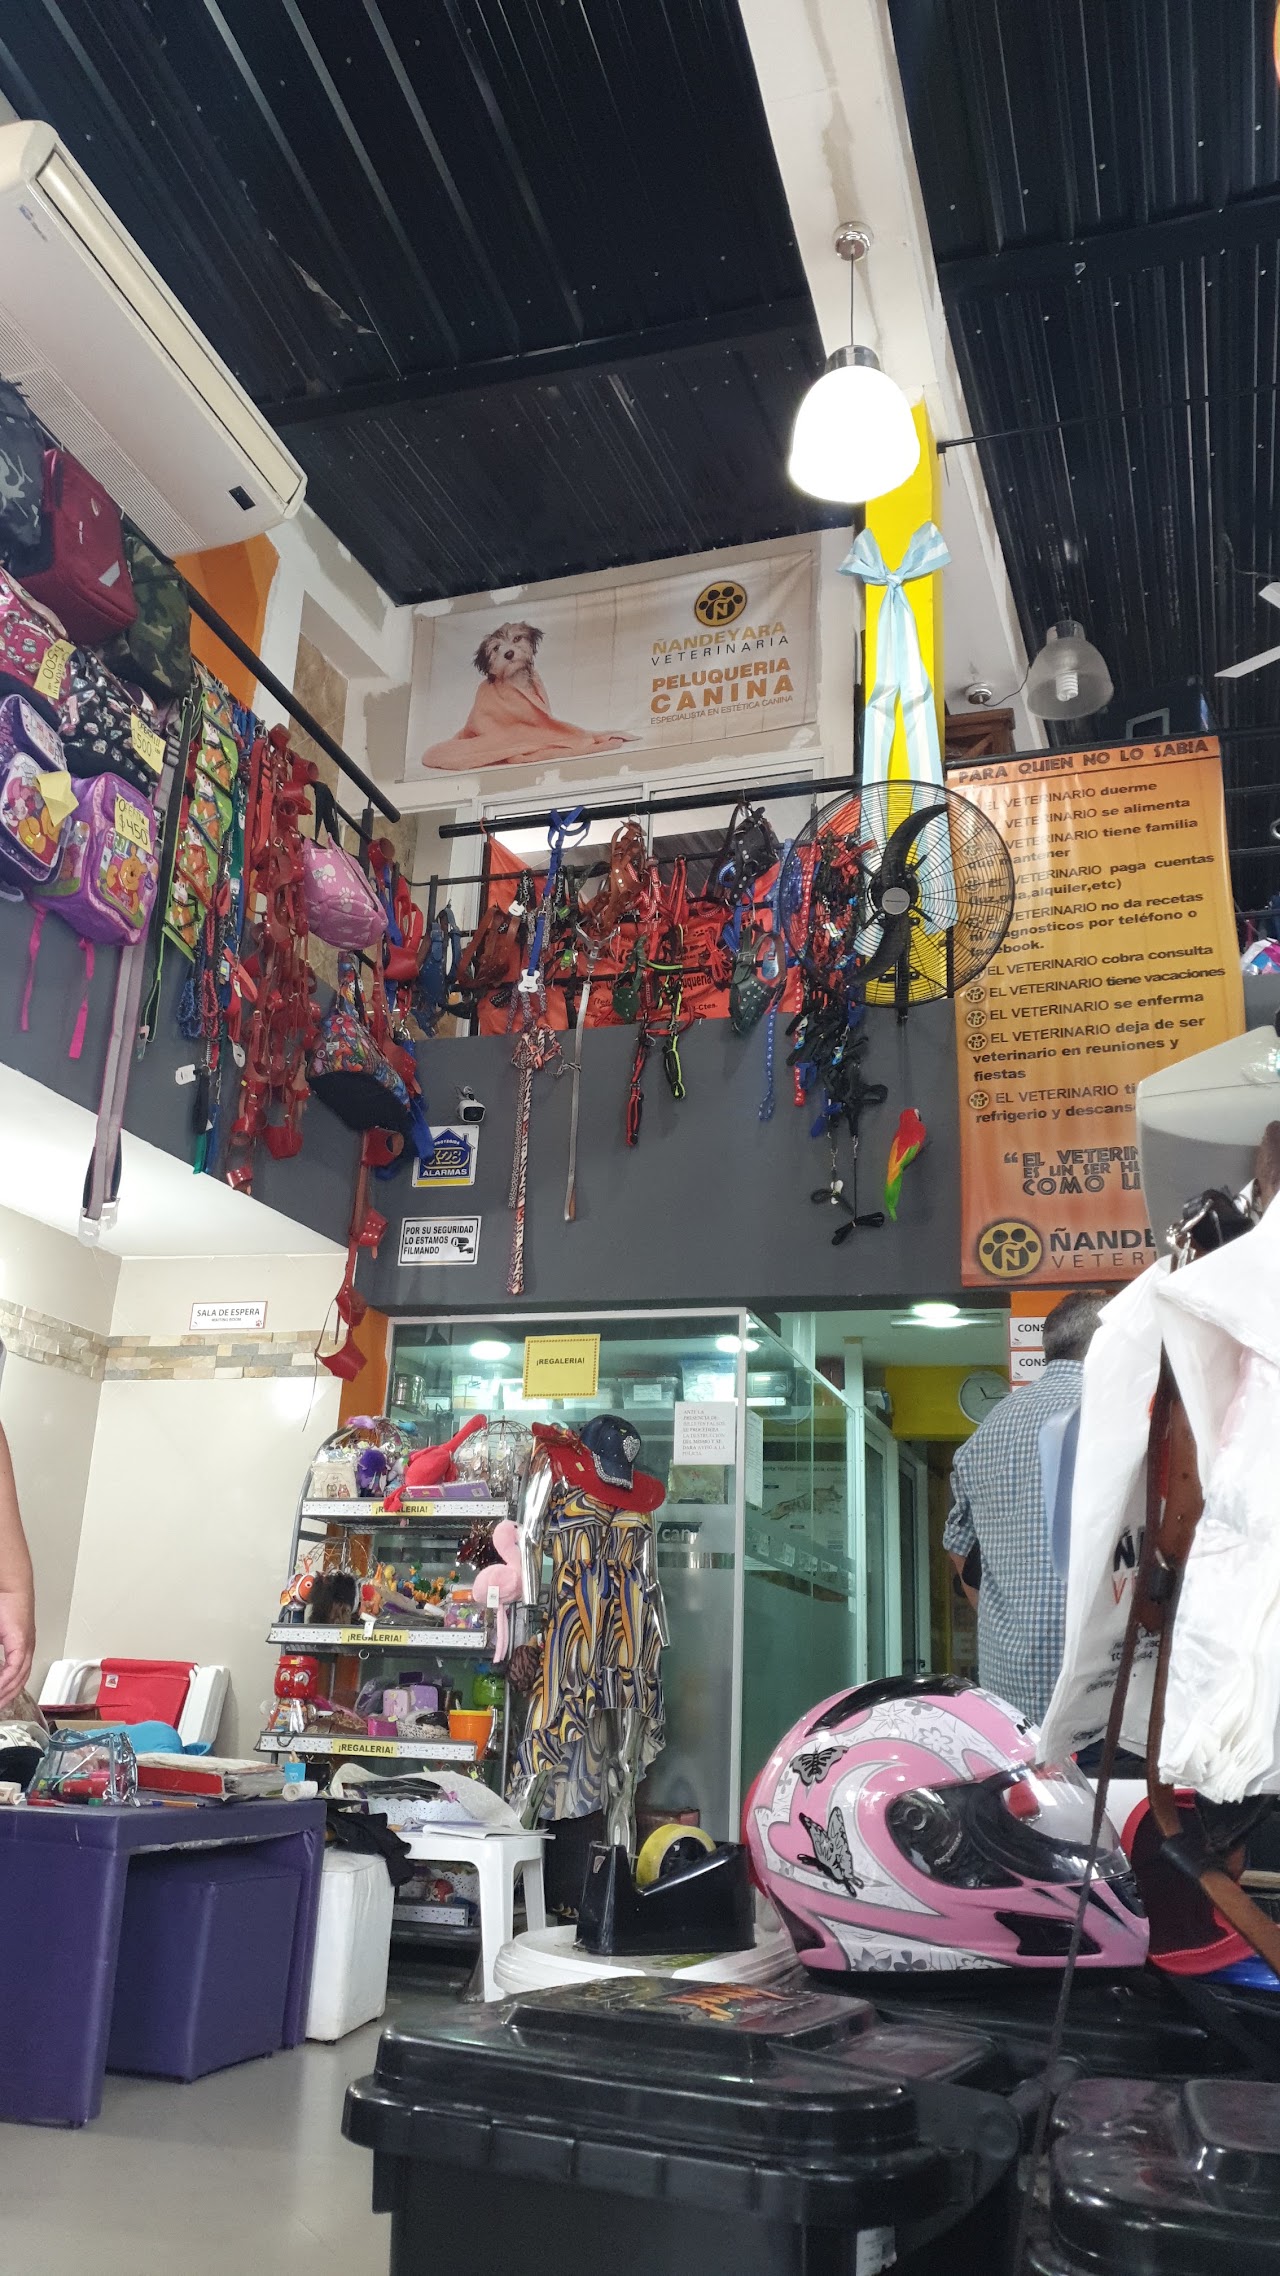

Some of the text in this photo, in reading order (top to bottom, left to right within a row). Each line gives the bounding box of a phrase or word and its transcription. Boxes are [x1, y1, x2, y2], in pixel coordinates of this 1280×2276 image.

[651, 635, 789, 666] VETERINARIA
[652, 621, 787, 656] ÑANDEYARA
[652, 657, 791, 693] PELUQUERIA
[650, 674, 795, 714] CANINA
[650, 710, 706, 725] ESPECIALISTA
[707, 708, 719, 717] EN
[761, 694, 794, 707] CANINA
[959, 739, 1210, 784] PARA QUIEN NO LO SABIA
[1005, 788, 1097, 808] VETERINARIO
[1100, 782, 1158, 797] duerme
[1005, 808, 1098, 829] VETERINARIO
[1101, 807, 1119, 818] se
[1123, 798, 1191, 816] alimenta
[119, 814, 148, 846] $450
[1006, 829, 1099, 850] VETERINARIO
[1102, 824, 1142, 838] tiene
[1145, 818, 1199, 834] familia
[1013, 865, 1102, 885] VETERINARIO
[1109, 861, 1147, 876] paga
[1154, 854, 1215, 870] cuentas
[1101, 902, 1120, 911] no
[1123, 898, 1142, 911] da
[1146, 892, 1205, 908] recetas
[988, 919, 1085, 941] dagnosticos
[1088, 917, 1115, 930] por
[1118, 907, 1184, 926] teléfono
[1187, 910, 1198, 920] o
[987, 944, 1214, 976] EL VETERINARIO cobra consulta
[989, 966, 1226, 998] EL VETERINARIO tiene vacaciones
[990, 991, 1205, 1021] EL VETERINARIO se enferma
[990, 1015, 1206, 1045] EL VETERINARIO deja de ser
[973, 1038, 1180, 1065] veterinario en reuniones y
[973, 1067, 1027, 1082] fiestas
[995, 1092, 1014, 1104] EL
[1018, 1084, 1119, 1102] VETERINARIO
[975, 1108, 1048, 1125] refrigerio
[1051, 1109, 1061, 1121] y
[422, 1168, 468, 1177] ALARMAS
[1023, 1166, 1040, 1179] ES
[1049, 1164, 1074, 1177] UN
[1083, 1162, 1112, 1176] SER
[1022, 1175, 1105, 1196] COMO
[404, 1236, 449, 1245] LO ESTAMOS
[405, 1225, 474, 1235] POR SU SEGURIDAD
[403, 1246, 440, 1255] FILMANDO
[197, 1309, 217, 1317] SALA
[230, 1308, 260, 1316] ESPERA
[536, 1357, 585, 1366] ¡REGALERIA!
[375, 1505, 428, 1515] ¡RLERIA!
[347, 1633, 402, 1642] ¡REGALERIA!
[338, 1743, 394, 1754] ¡REGALERIA!
